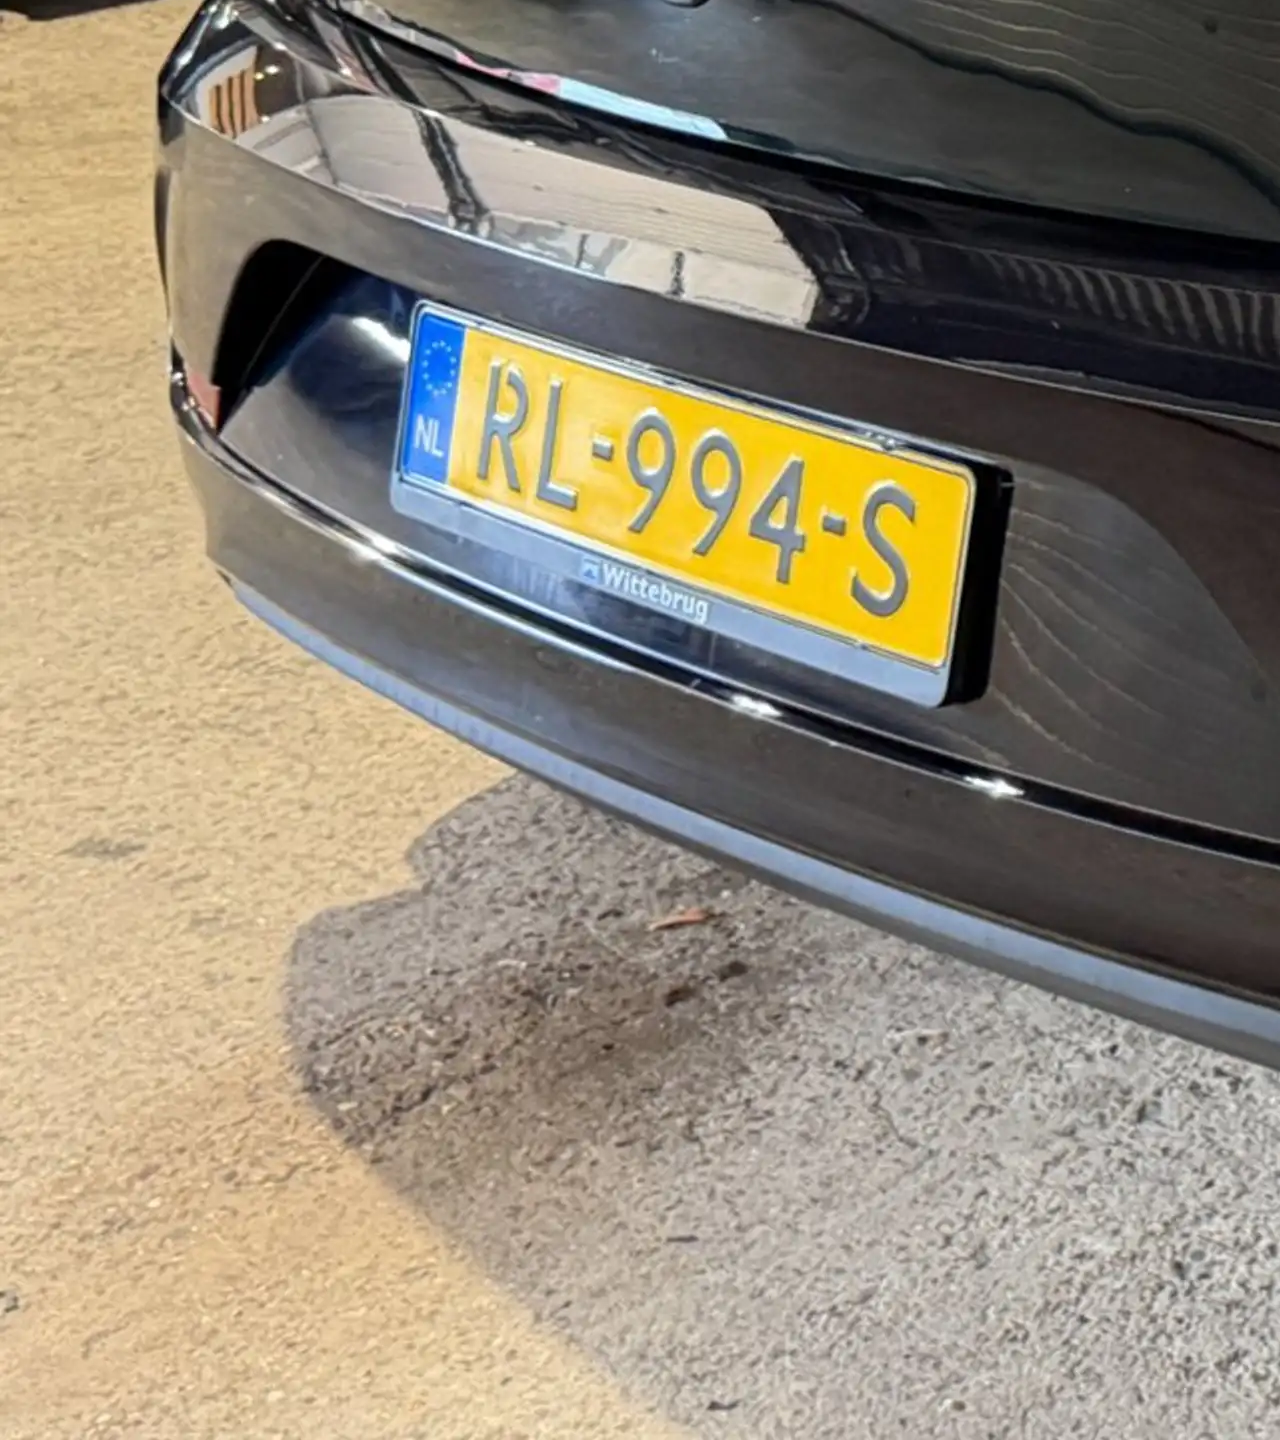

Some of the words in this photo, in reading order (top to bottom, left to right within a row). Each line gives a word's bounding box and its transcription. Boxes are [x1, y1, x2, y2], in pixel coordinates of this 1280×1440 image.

[413, 414, 444, 458] NL
[476, 356, 917, 618] RL-994-S
[601, 563, 709, 625] Wittebrug
